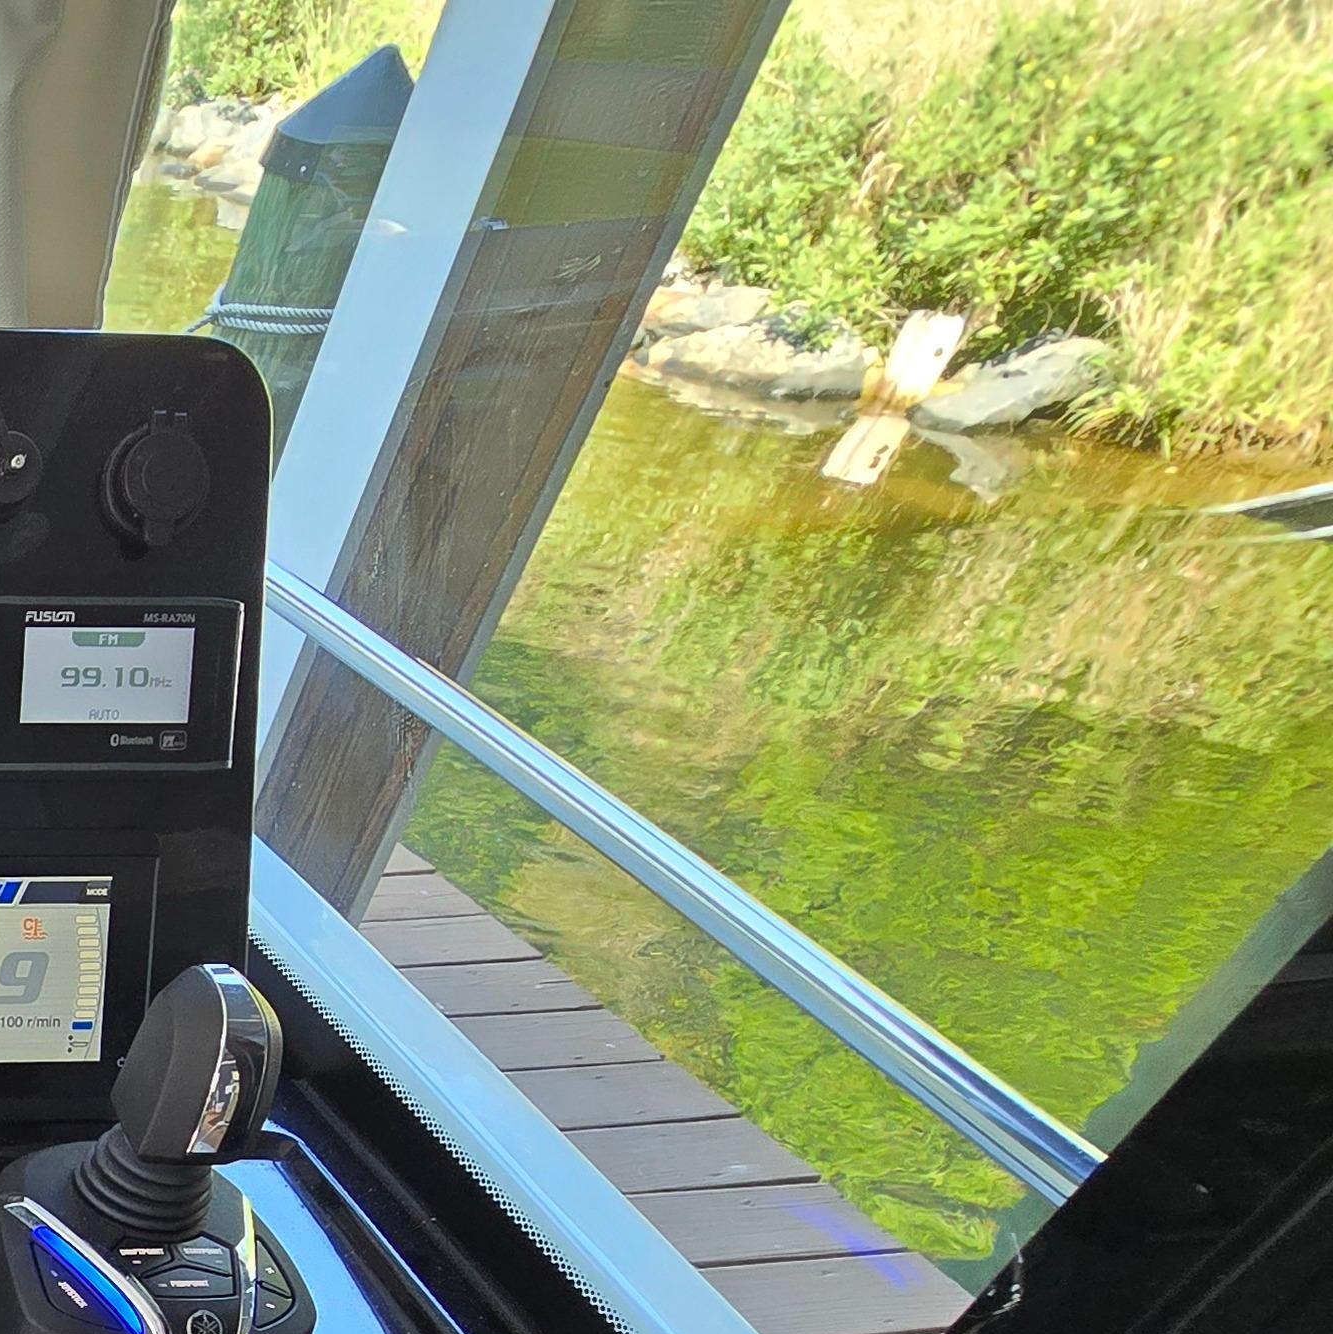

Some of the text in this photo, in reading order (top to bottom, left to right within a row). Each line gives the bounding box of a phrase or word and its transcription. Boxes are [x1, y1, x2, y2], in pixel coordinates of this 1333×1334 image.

[142, 612, 196, 624] MS-RA70N
[98, 634, 119, 646] FM
[61, 667, 150, 688] 99.10
[88, 709, 120, 721] AUTO
[86, 887, 108, 897] MODE
[26, 1015, 61, 1028] r/min
